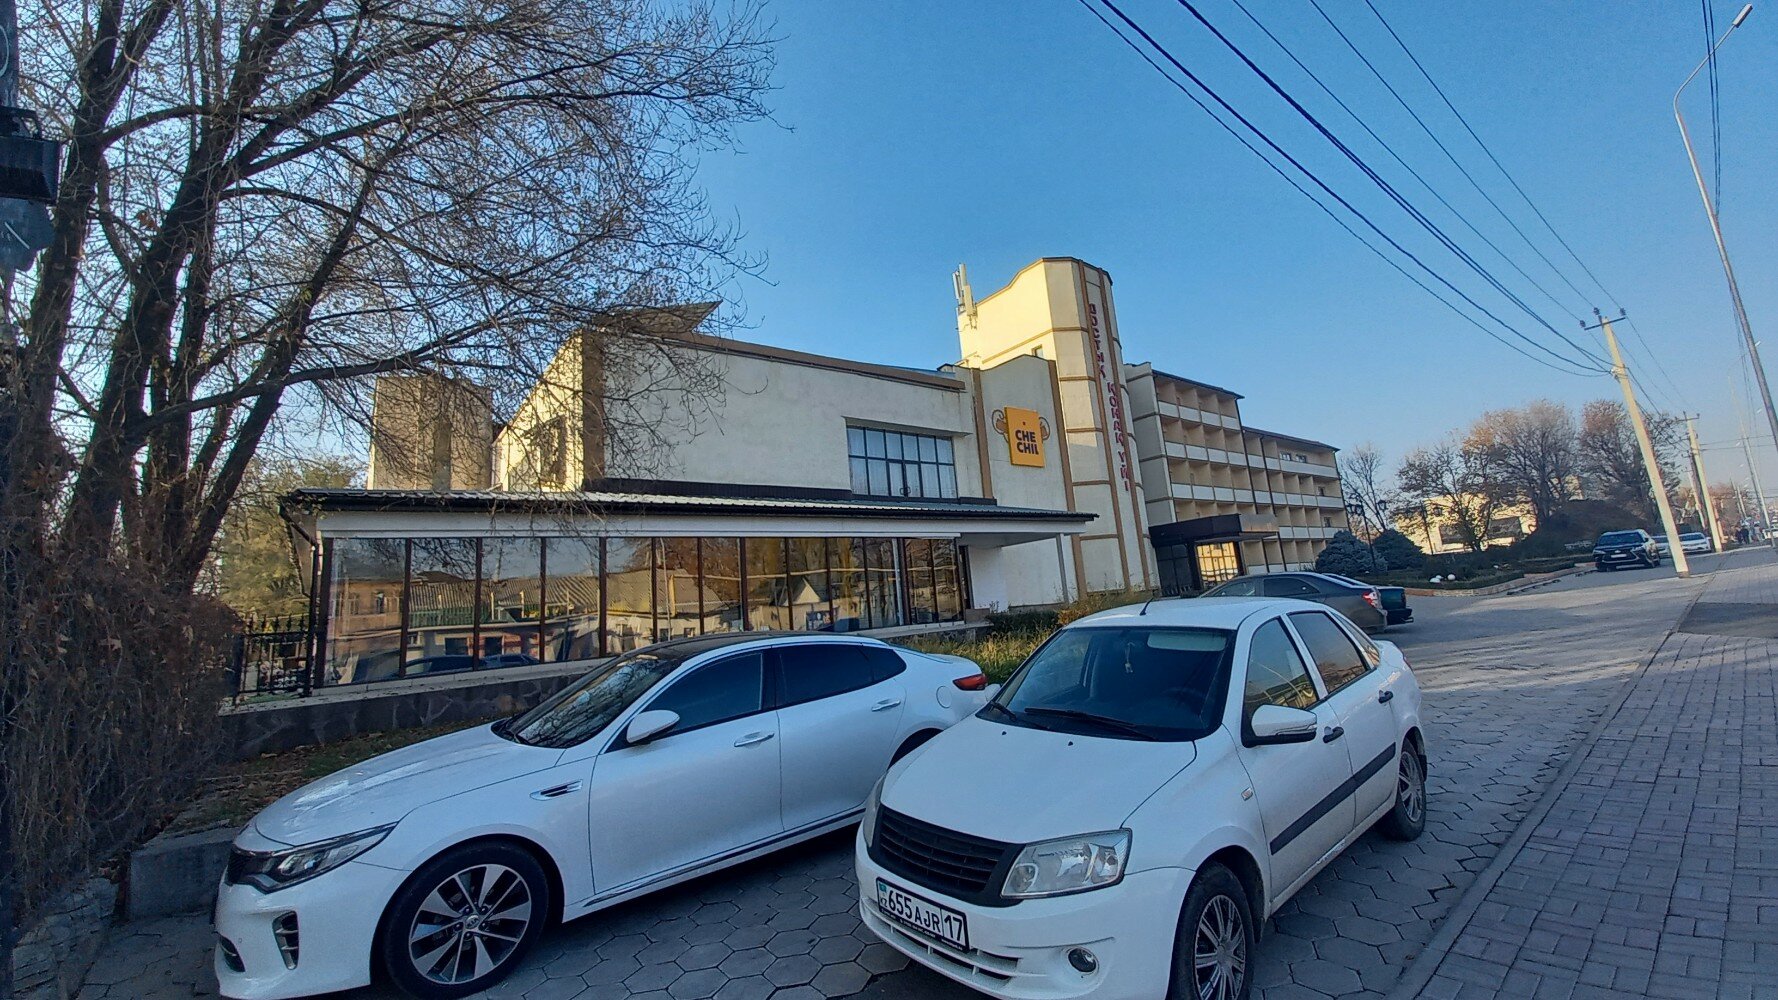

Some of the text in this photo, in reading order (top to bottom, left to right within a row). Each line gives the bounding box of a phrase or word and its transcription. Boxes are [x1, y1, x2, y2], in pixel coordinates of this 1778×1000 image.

[1015, 429, 1036, 443] CHE
[1016, 442, 1039, 455] CHIL
[944, 914, 963, 942] 17
